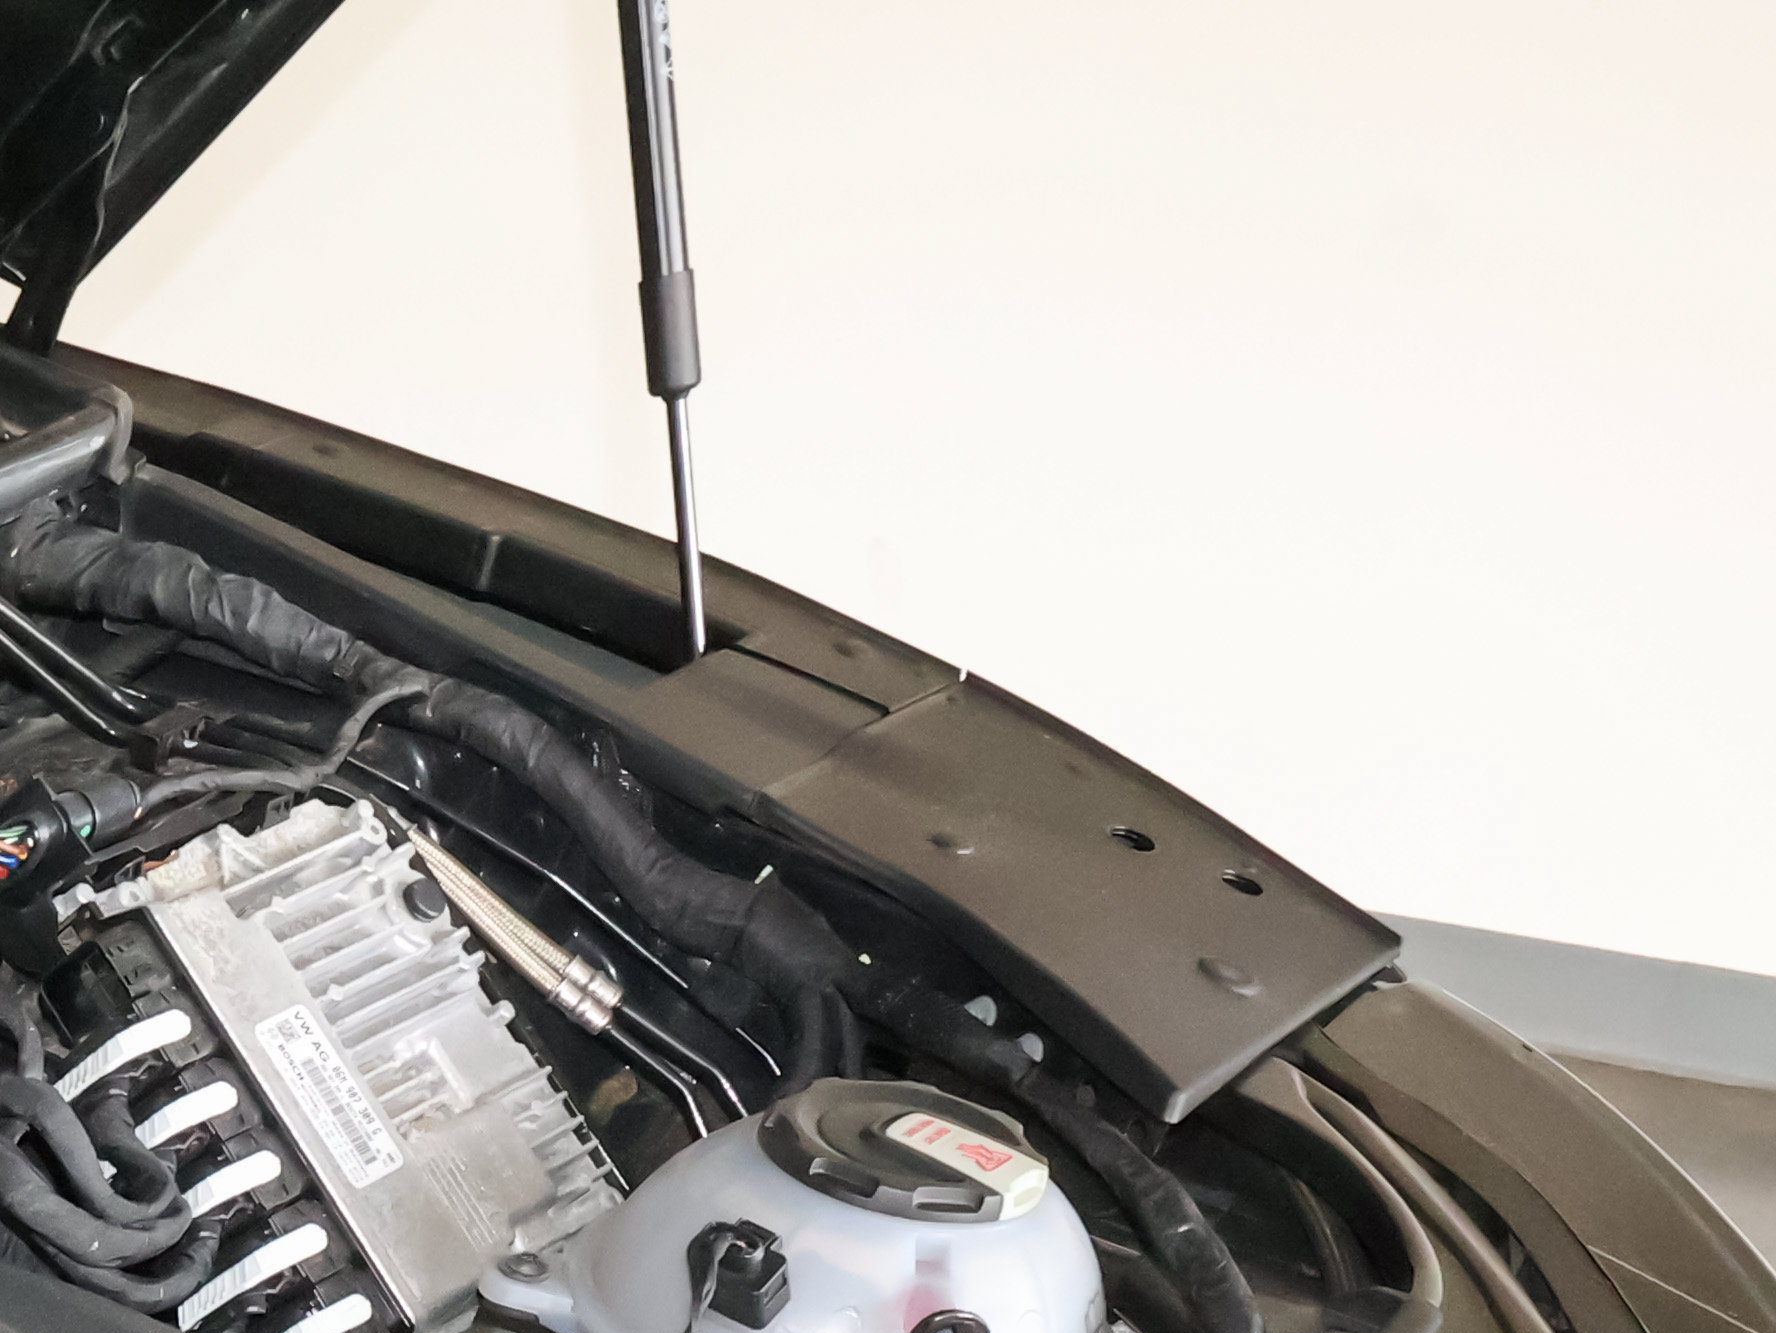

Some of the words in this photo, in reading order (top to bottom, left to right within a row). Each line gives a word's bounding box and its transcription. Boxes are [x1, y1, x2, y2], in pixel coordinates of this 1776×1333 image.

[293, 1010, 314, 1036] VW
[311, 1041, 330, 1063] AG
[277, 1044, 305, 1081] BOSCH
